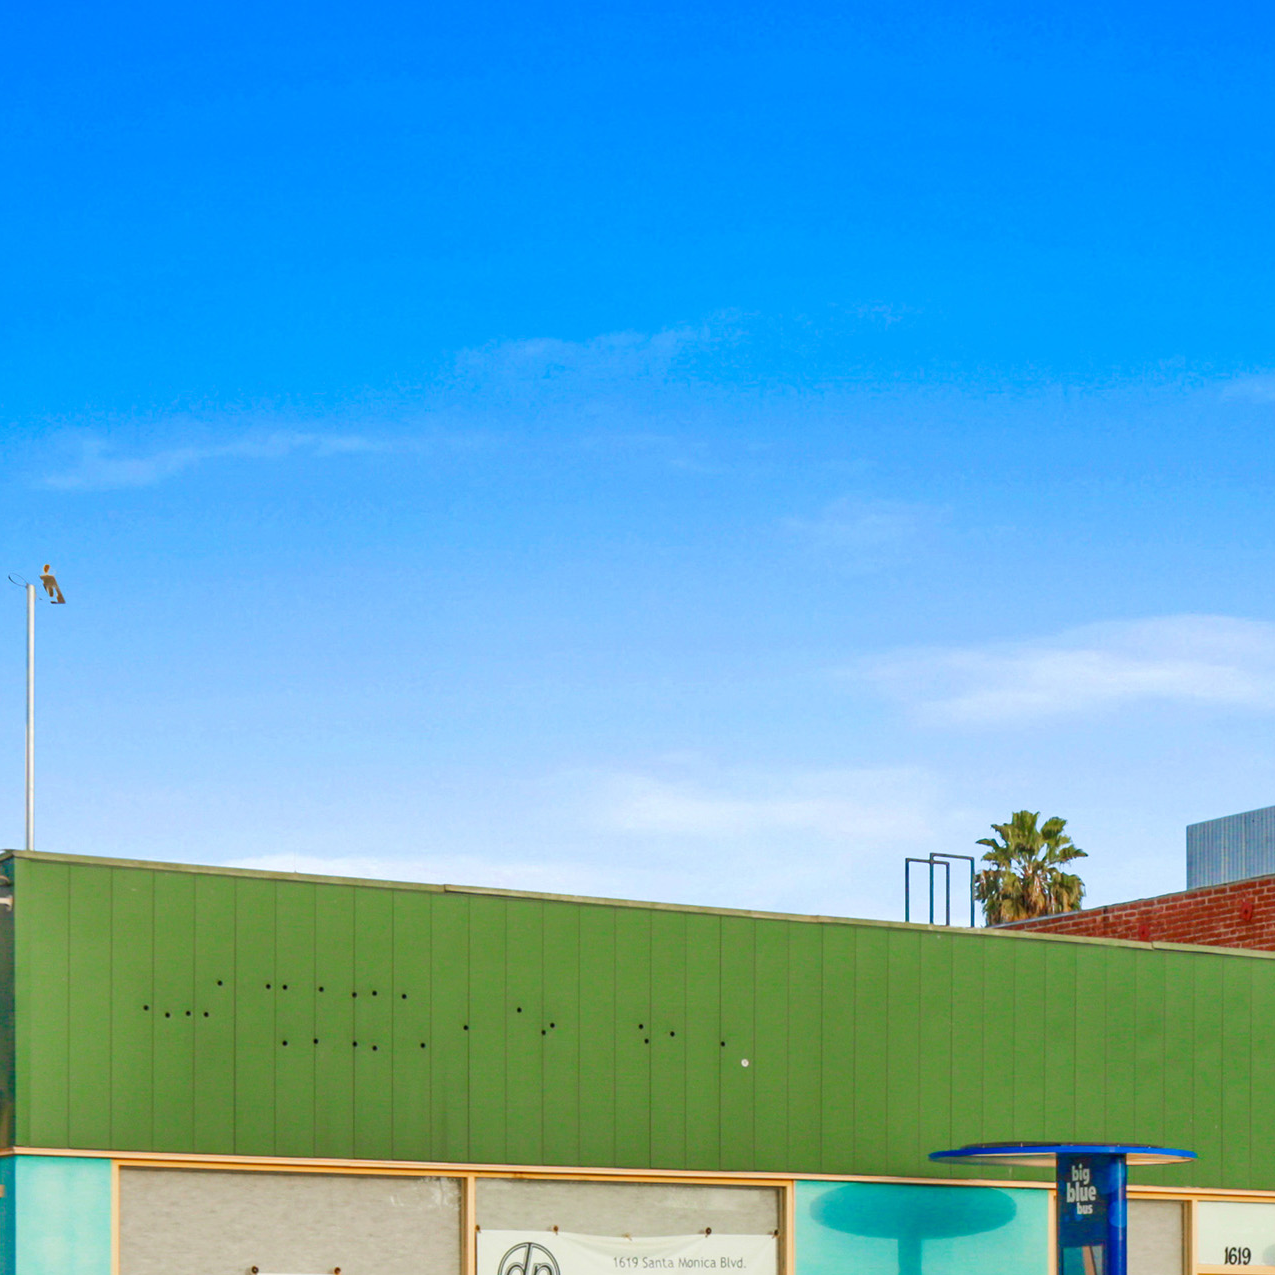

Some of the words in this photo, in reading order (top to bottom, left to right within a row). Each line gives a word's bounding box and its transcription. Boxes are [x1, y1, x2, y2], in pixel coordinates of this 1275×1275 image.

[1072, 1164, 1090, 1185] big
[1066, 1182, 1096, 1203] blue
[1077, 1202, 1093, 1214] bus
[614, 1257, 639, 1268] 1619
[642, 1257, 674, 1268] Santa
[678, 1258, 716, 1268] Monica
[720, 1257, 746, 1268] Blvd.
[1224, 1246, 1251, 1265] 1619
